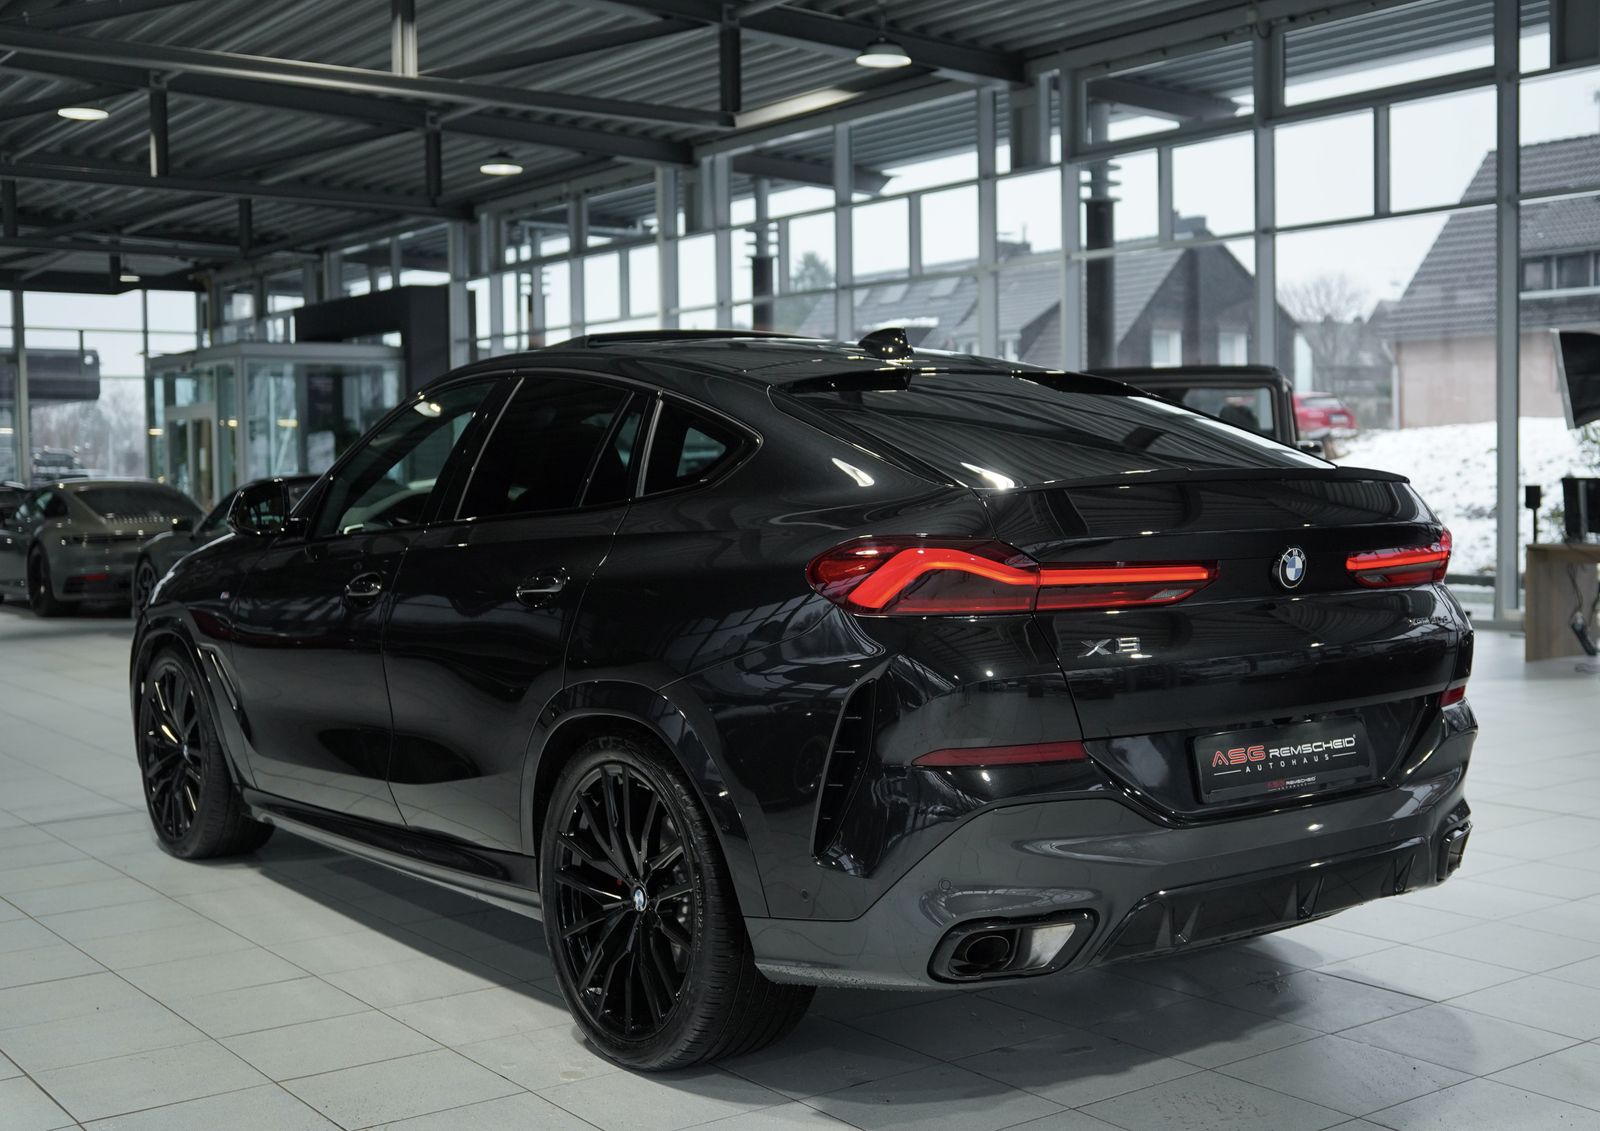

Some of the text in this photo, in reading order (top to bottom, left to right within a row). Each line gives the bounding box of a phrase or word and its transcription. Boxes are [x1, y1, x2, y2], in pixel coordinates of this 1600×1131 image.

[1077, 637, 1141, 658] X6
[1212, 737, 1356, 767] ASG REMSCHEID
[1245, 753, 1330, 773] AUTOHAUS
